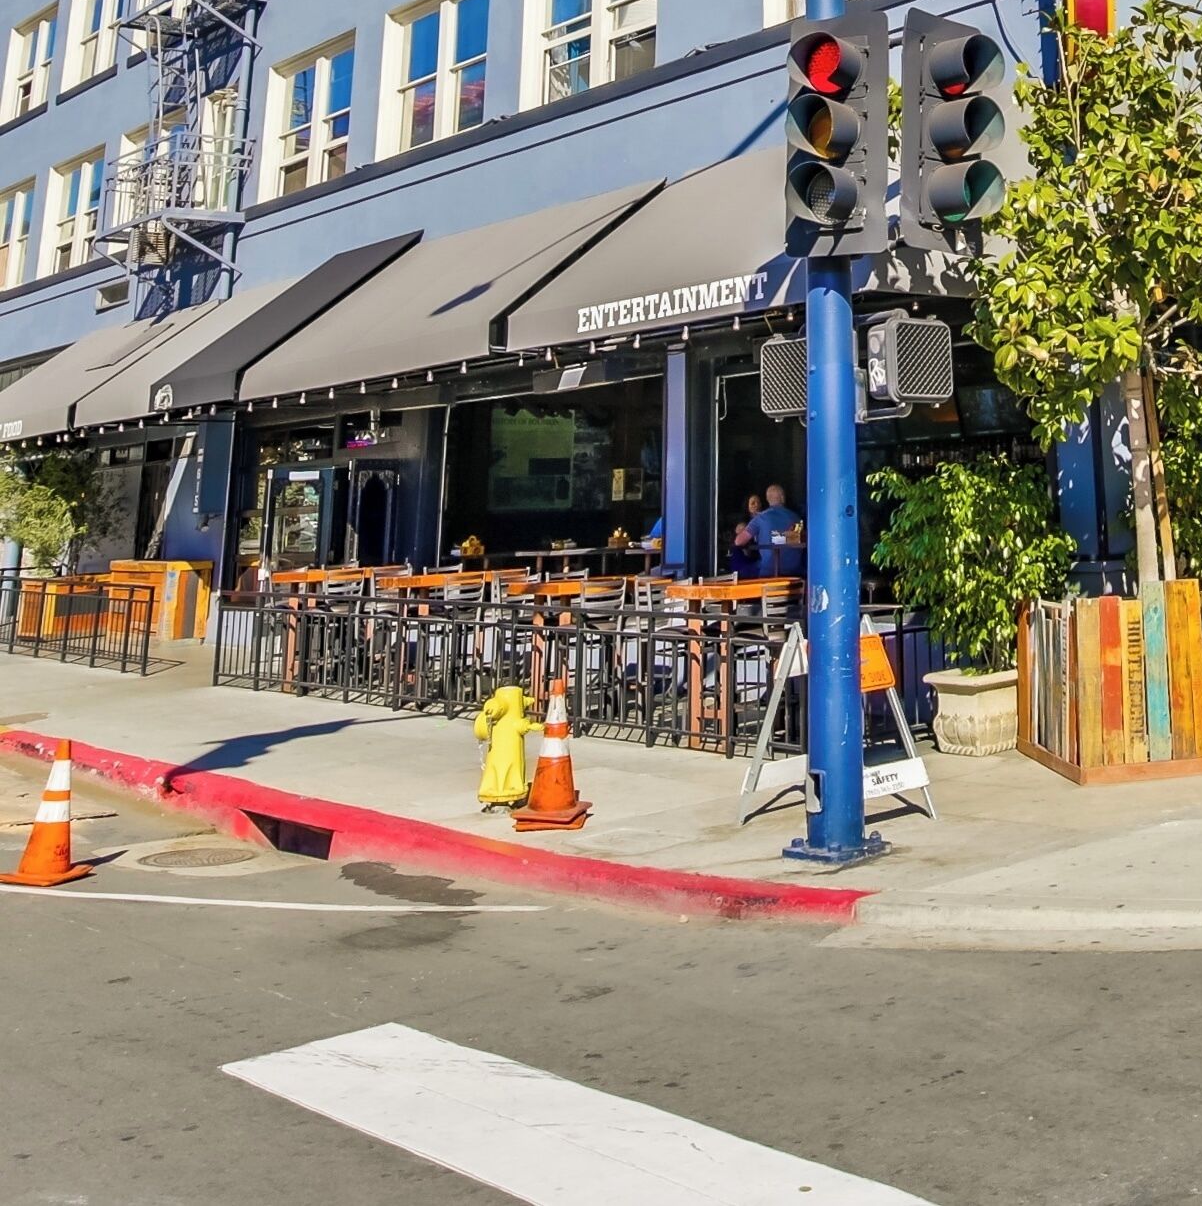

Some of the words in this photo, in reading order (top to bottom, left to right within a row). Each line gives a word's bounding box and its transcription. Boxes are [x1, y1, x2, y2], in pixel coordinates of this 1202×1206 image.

[576, 271, 768, 334] ENTERTAINMENT
[2, 419, 23, 439] FOOD
[872, 772, 898, 786] SAFETY
